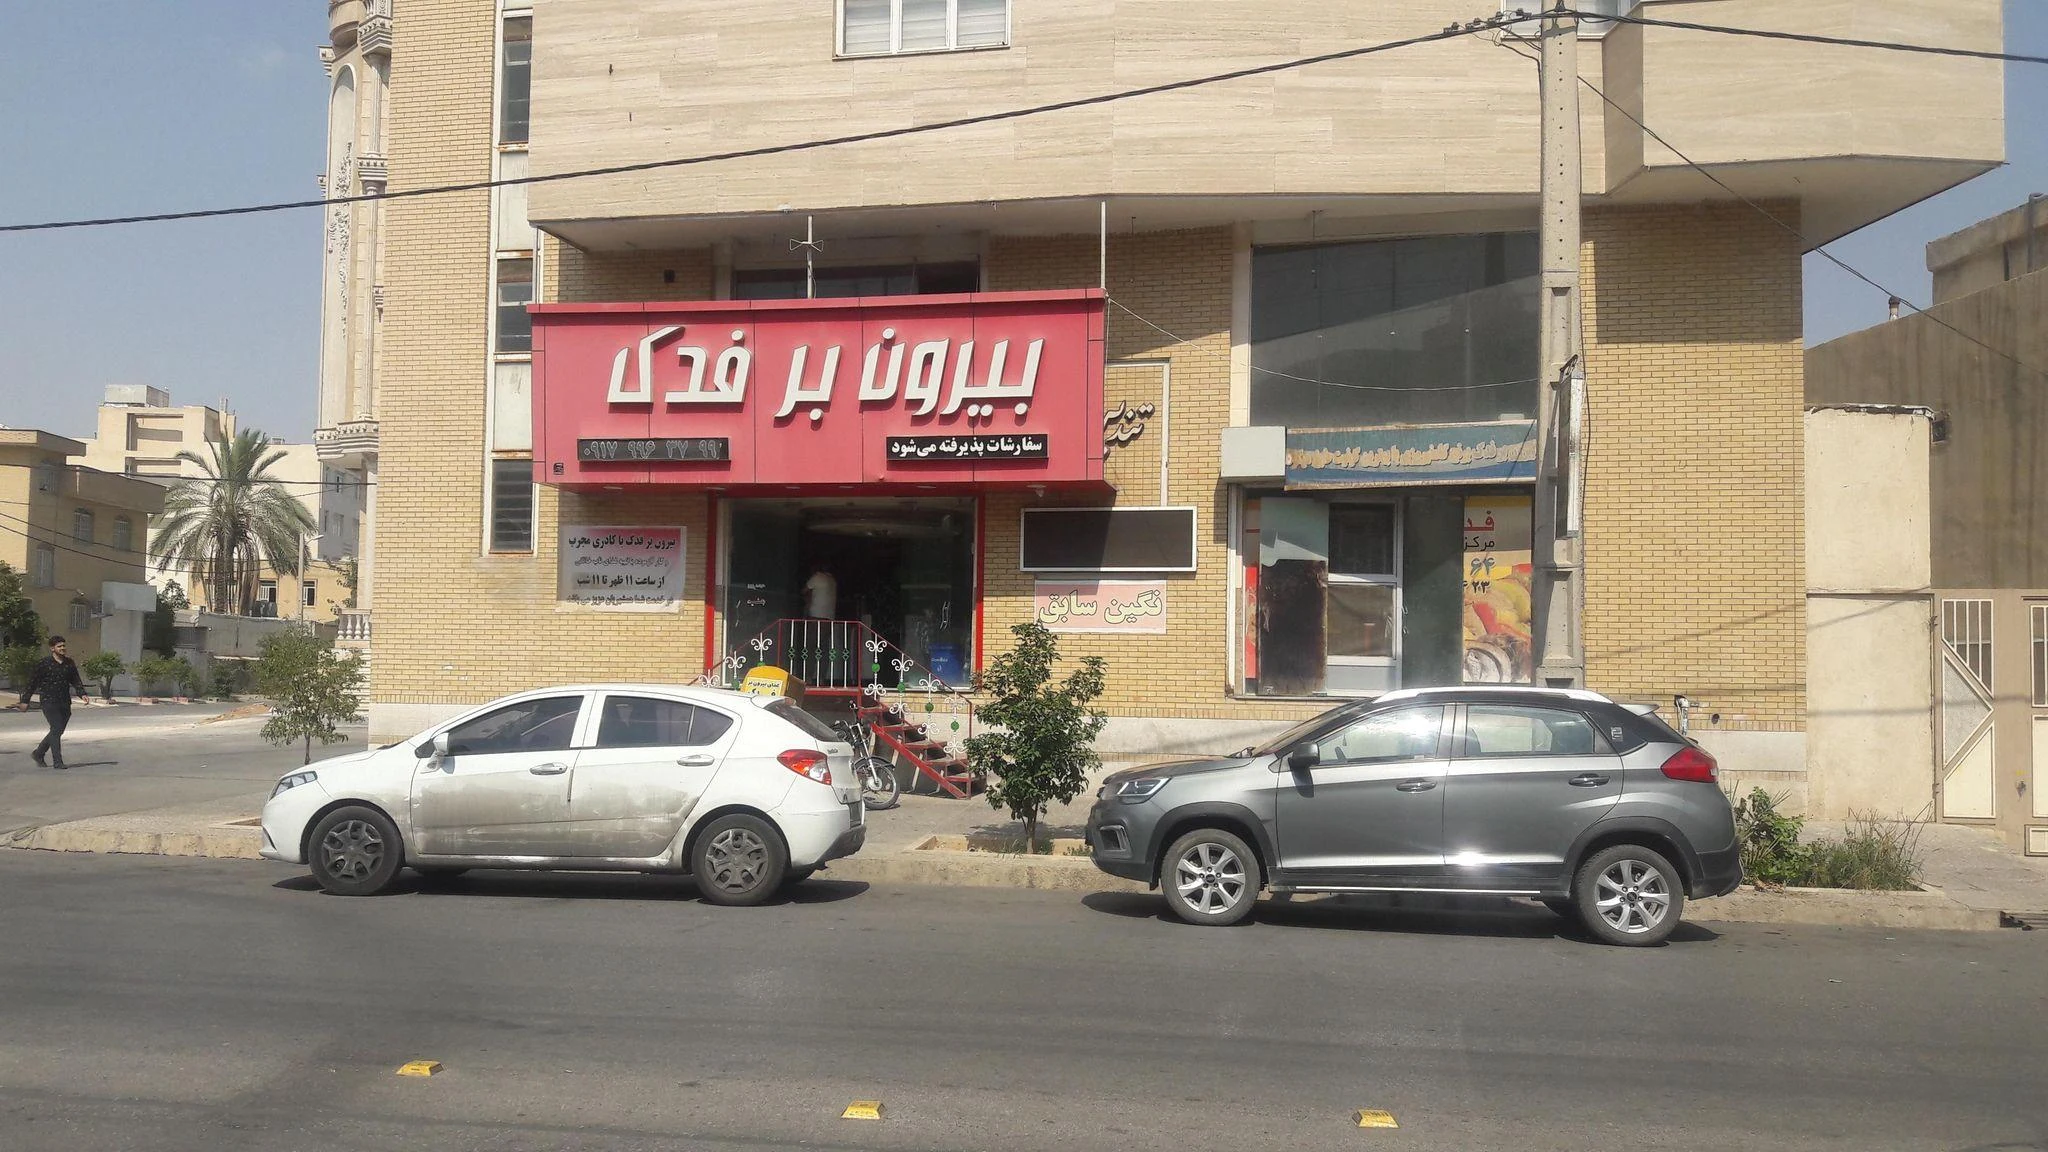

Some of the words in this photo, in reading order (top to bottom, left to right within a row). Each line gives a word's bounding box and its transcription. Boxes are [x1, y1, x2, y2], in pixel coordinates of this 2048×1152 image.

[606, 325, 751, 403] فدک
[858, 326, 1044, 417] بیرون
[774, 344, 841, 421] بر
[583, 440, 618, 459] ۰۹۱۷
[666, 440, 689, 459] ۳۷
[938, 436, 984, 457] پذیرفته
[986, 436, 1043, 456] سفارشات
[1463, 536, 1495, 551] مرکز
[1039, 589, 1097, 624] سابق
[1104, 589, 1163, 624] نگین
